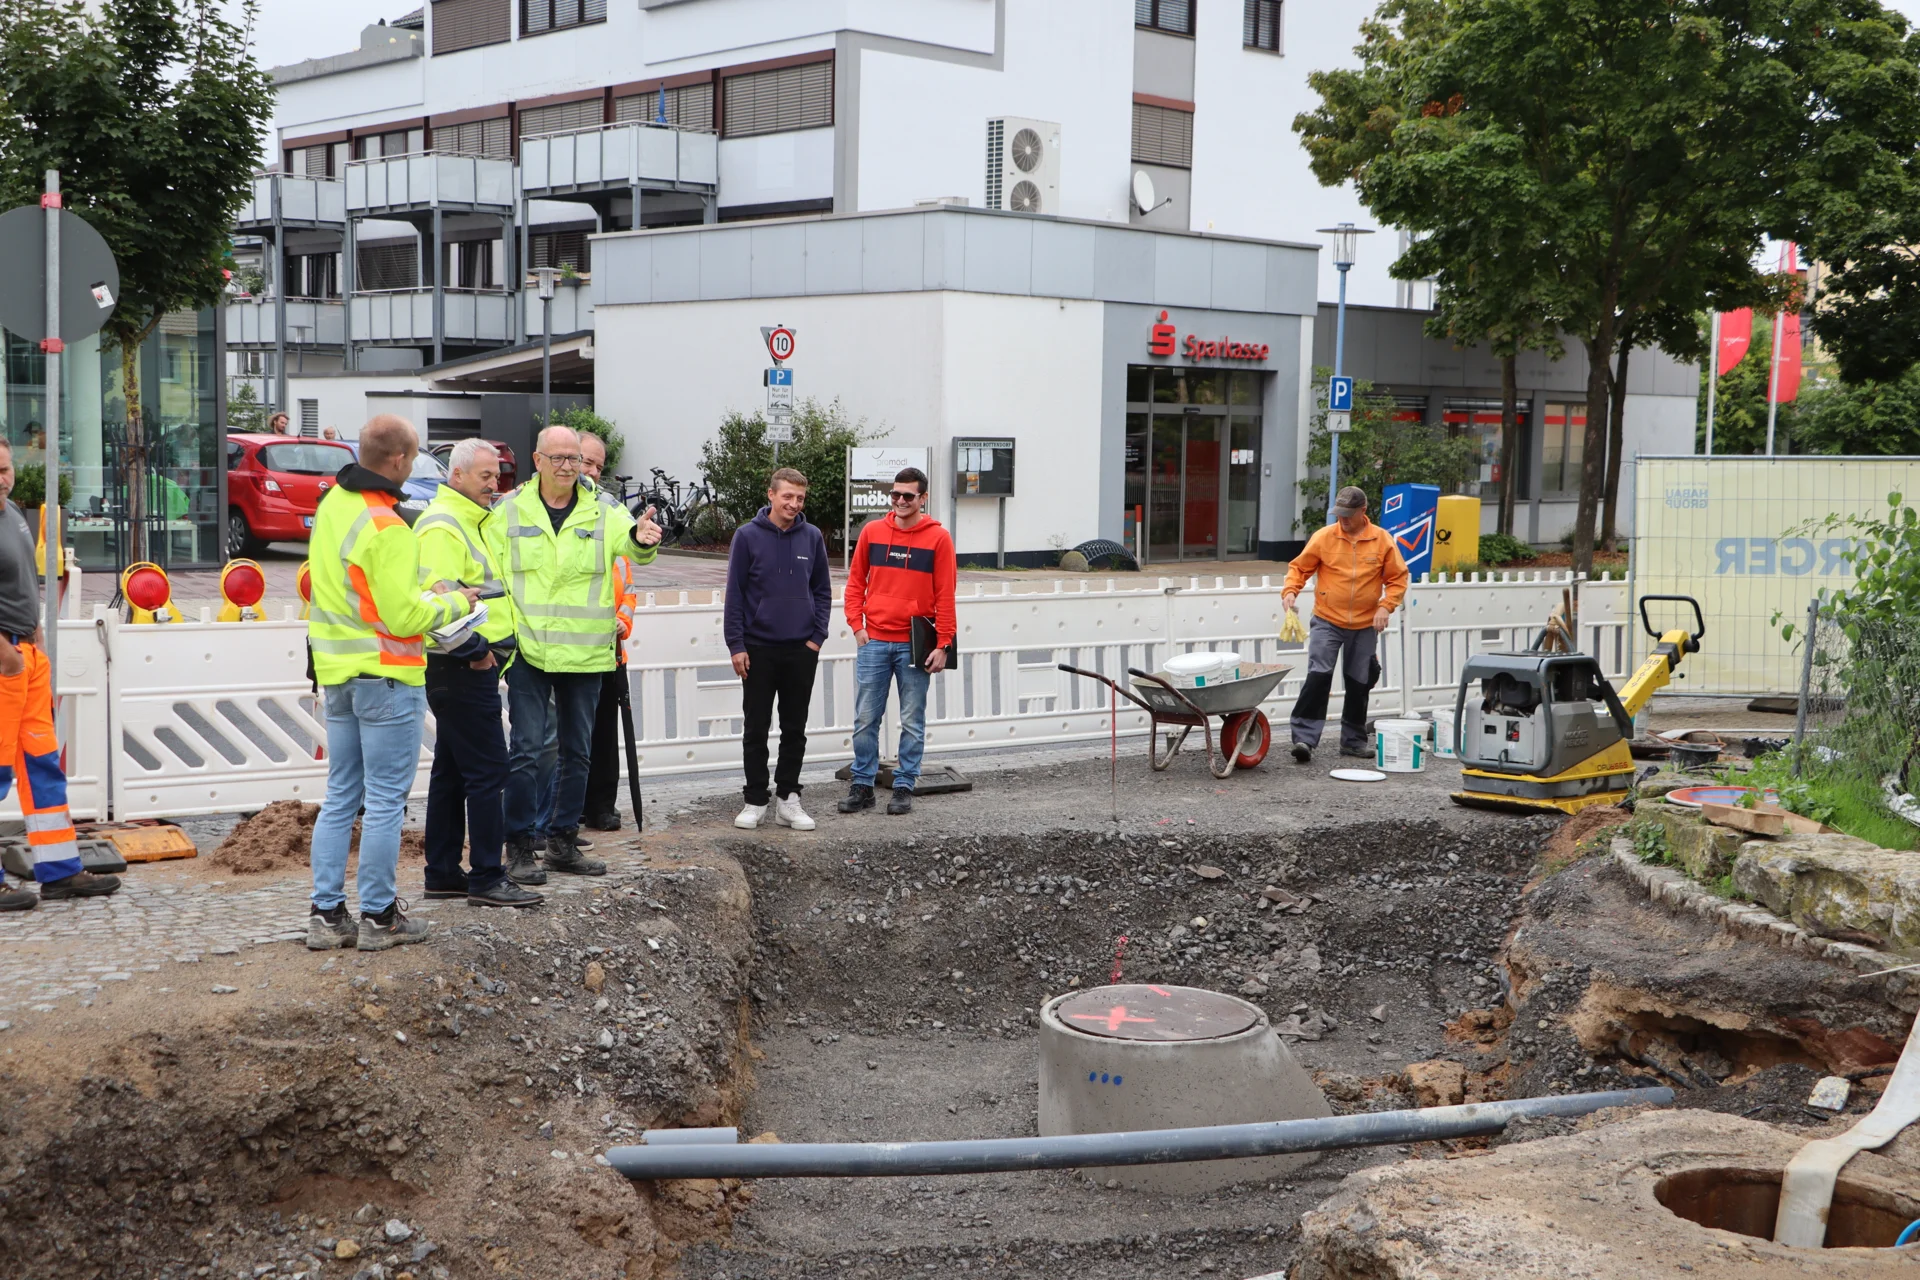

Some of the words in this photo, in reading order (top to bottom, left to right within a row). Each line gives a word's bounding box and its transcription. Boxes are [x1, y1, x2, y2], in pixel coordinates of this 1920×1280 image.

[776, 337, 788, 351] 10
[1186, 334, 1269, 361] Sparkasse
[776, 371, 785, 384] P
[1335, 381, 1347, 406] P
